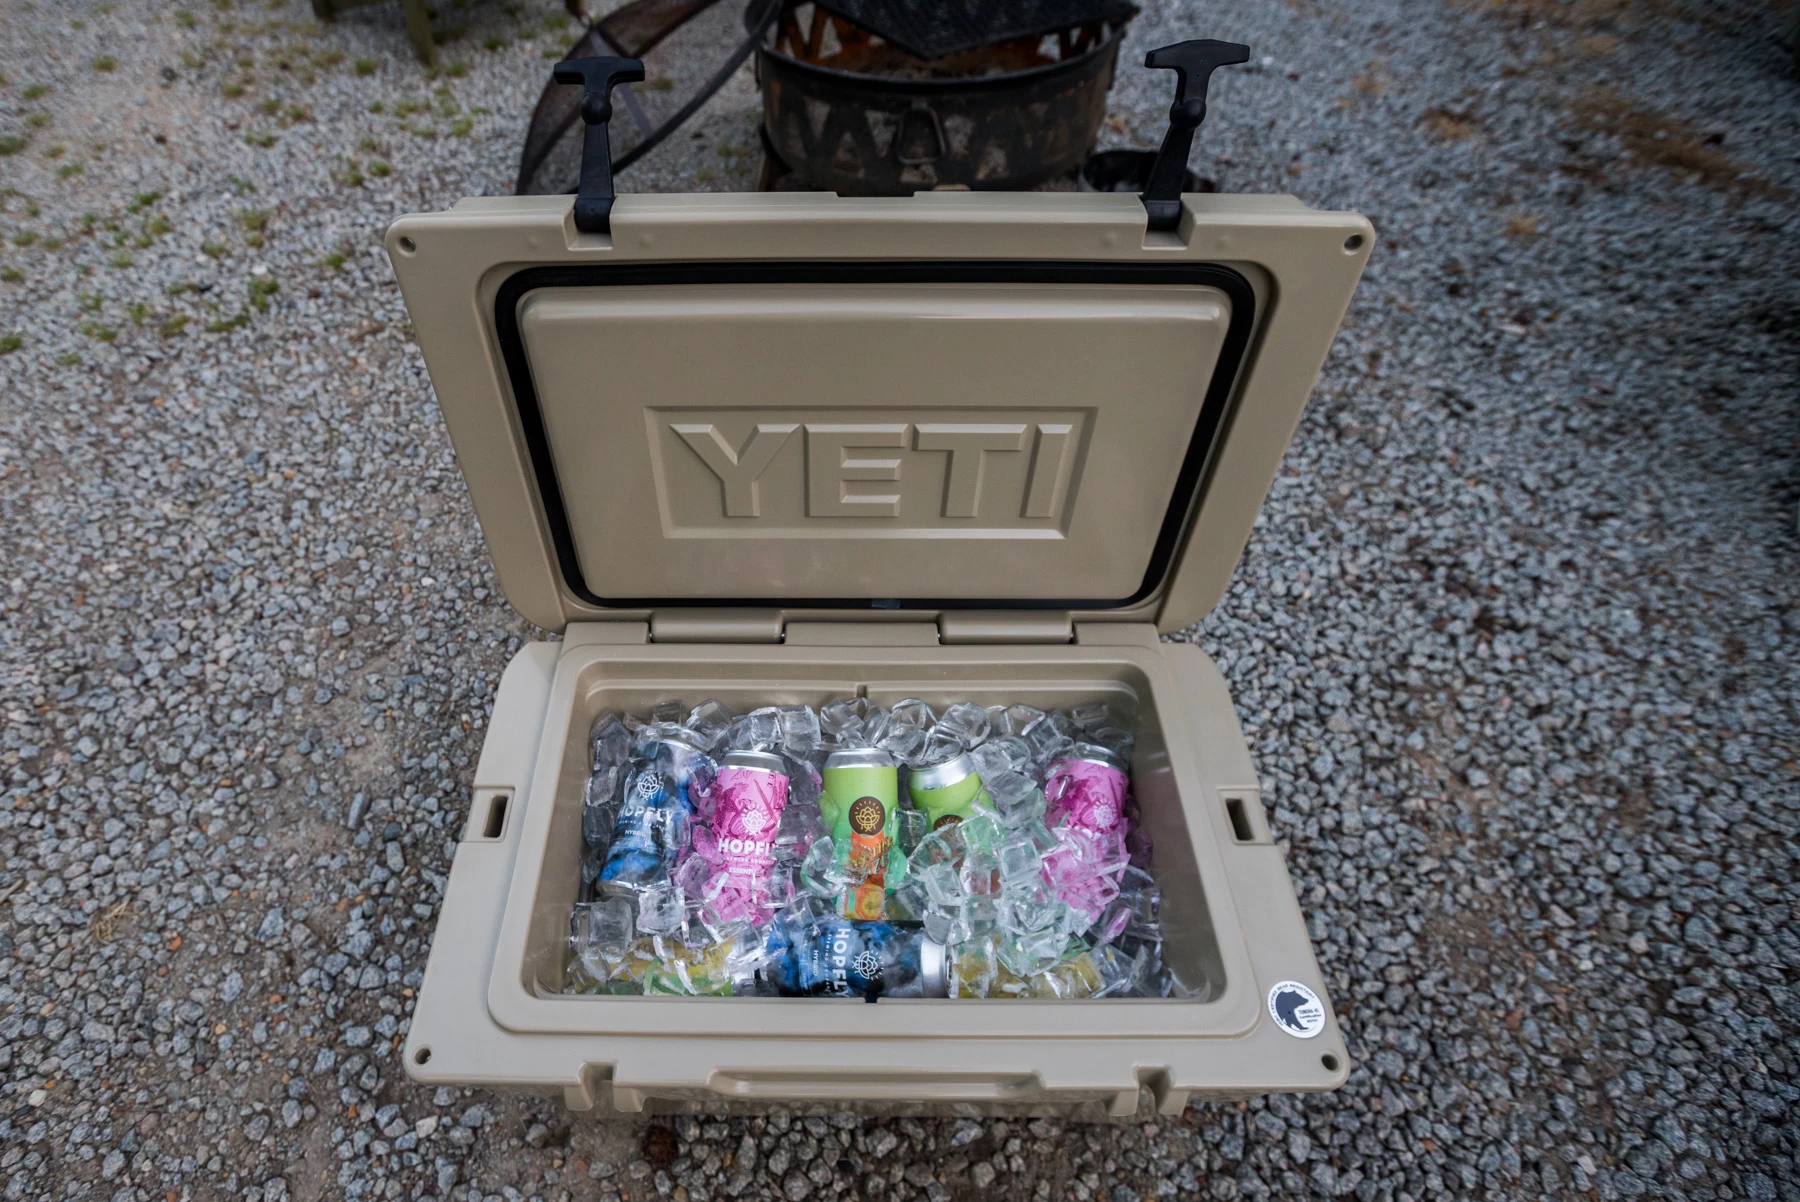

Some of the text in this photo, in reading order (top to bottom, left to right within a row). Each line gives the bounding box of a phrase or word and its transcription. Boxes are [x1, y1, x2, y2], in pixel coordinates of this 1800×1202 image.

[669, 424, 1073, 518] YETI
[618, 804, 673, 825] HOPFLY
[832, 928, 851, 998] HOPFLY
